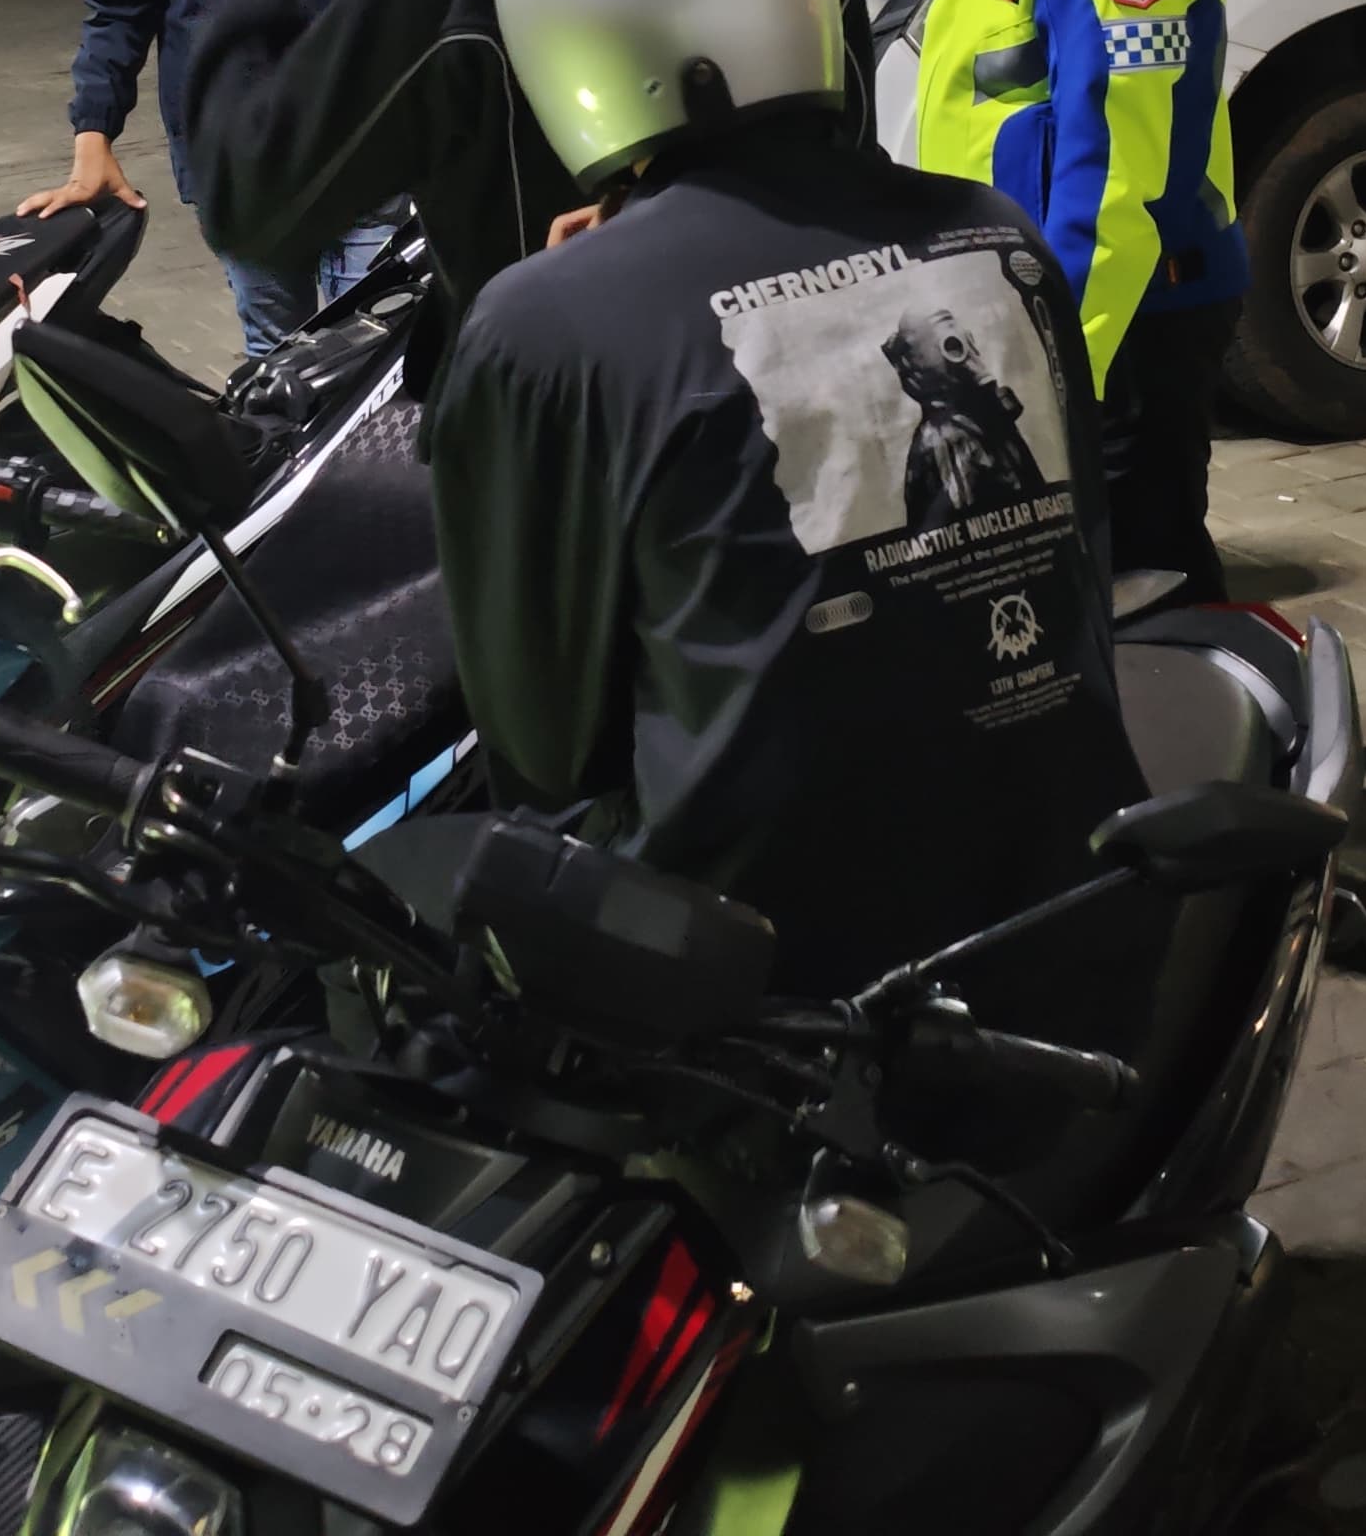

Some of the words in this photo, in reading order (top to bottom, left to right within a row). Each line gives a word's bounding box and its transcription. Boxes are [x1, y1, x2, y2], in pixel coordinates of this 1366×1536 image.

[710, 244, 922, 318] CHERNOBYL
[864, 522, 965, 573] RADIOACTIVE
[966, 502, 1033, 542] NUCLEAR
[307, 1114, 406, 1182] YAMAHA
[40, 1140, 113, 1222] E
[129, 1176, 315, 1304] 2750
